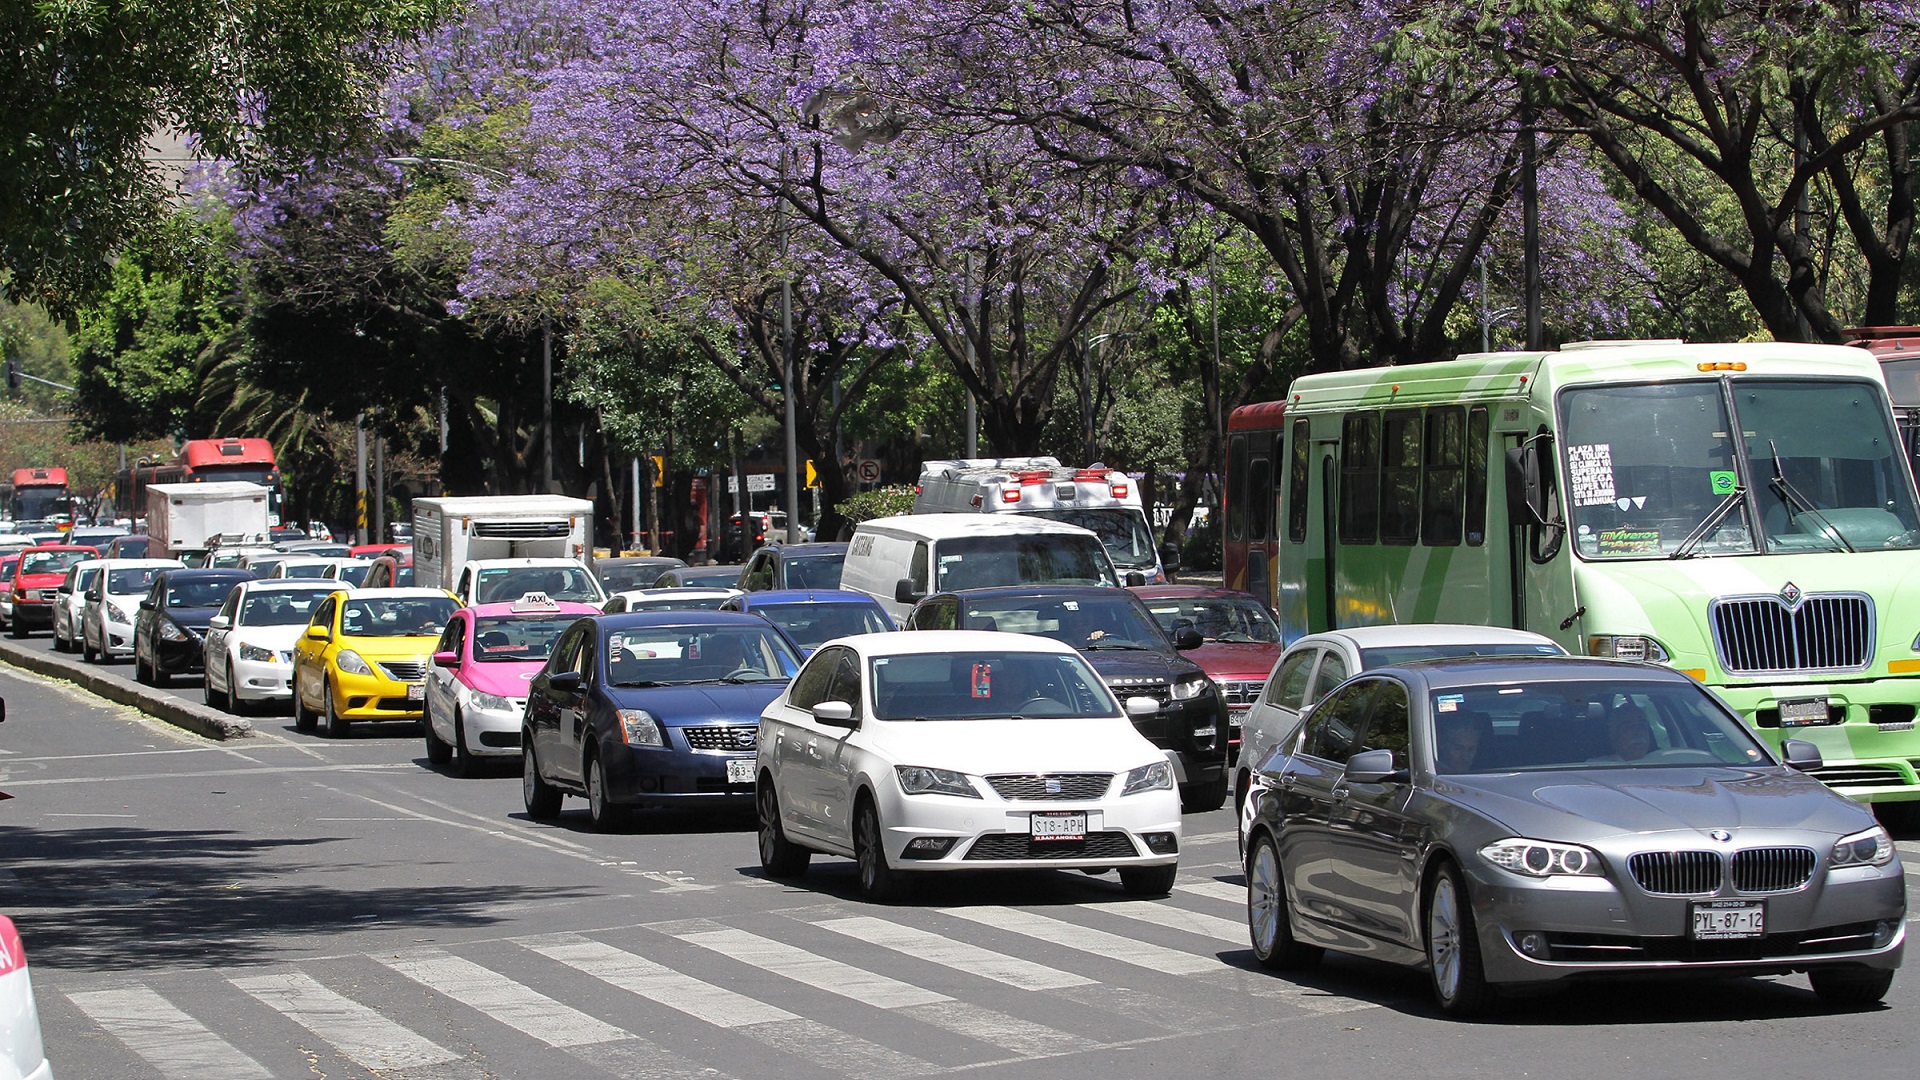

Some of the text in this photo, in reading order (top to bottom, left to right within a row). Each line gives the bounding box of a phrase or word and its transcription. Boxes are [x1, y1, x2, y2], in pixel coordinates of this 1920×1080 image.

[1568, 444, 1610, 454] PLAZA INN
[1581, 452, 1610, 460] TOLUCA
[1570, 467, 1612, 476] SUPERAMA
[1572, 482, 1599, 492] SUPER
[1583, 497, 1616, 506] ANAHUAC
[526, 595, 546, 603] TAXI
[730, 766, 756, 777] 983-
[1035, 820, 1084, 833] S18-APH
[1694, 912, 1762, 929] PYL-87-12
